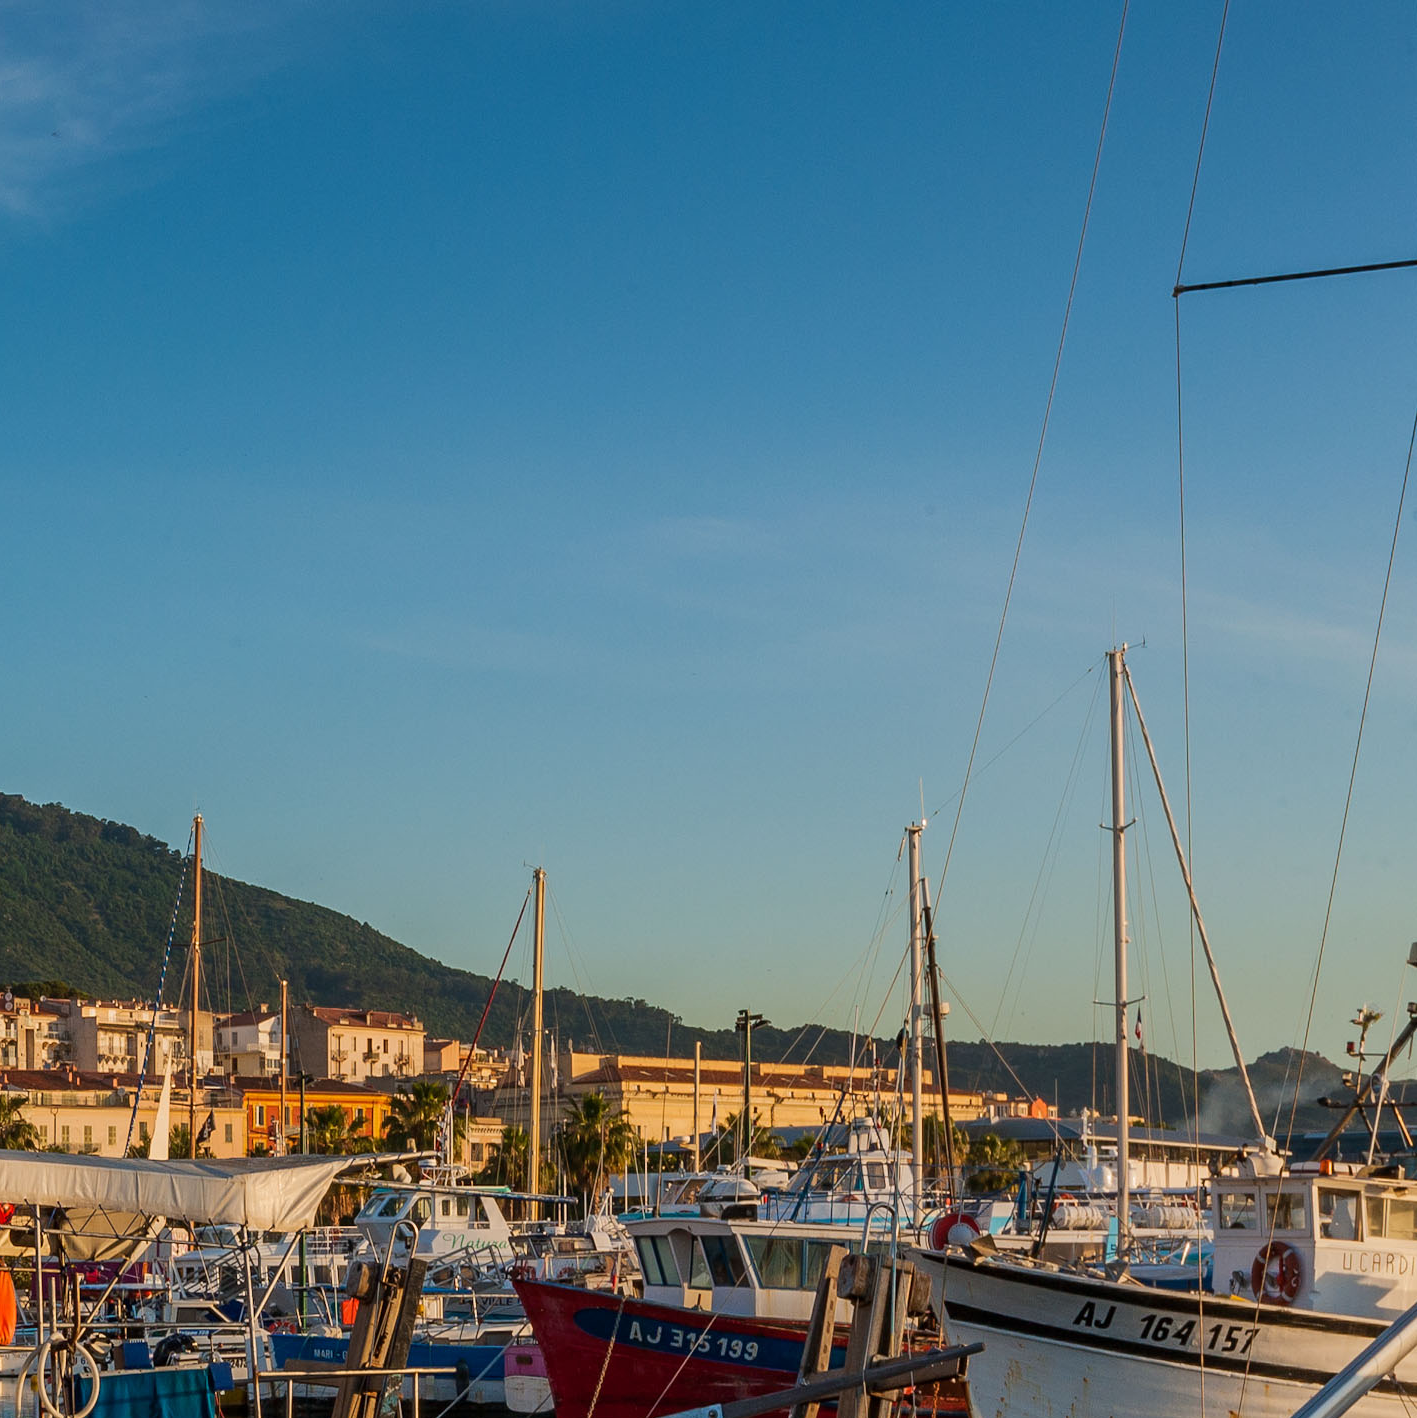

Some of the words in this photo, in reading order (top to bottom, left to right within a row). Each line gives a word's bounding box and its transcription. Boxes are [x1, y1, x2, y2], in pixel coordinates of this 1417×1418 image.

[629, 1321, 663, 1344] AJ
[670, 1328, 712, 1353] 315
[717, 1337, 759, 1361] 199
[1073, 1301, 1117, 1330] AJ
[1140, 1314, 1197, 1346] 164
[1208, 1323, 1261, 1354] 157
